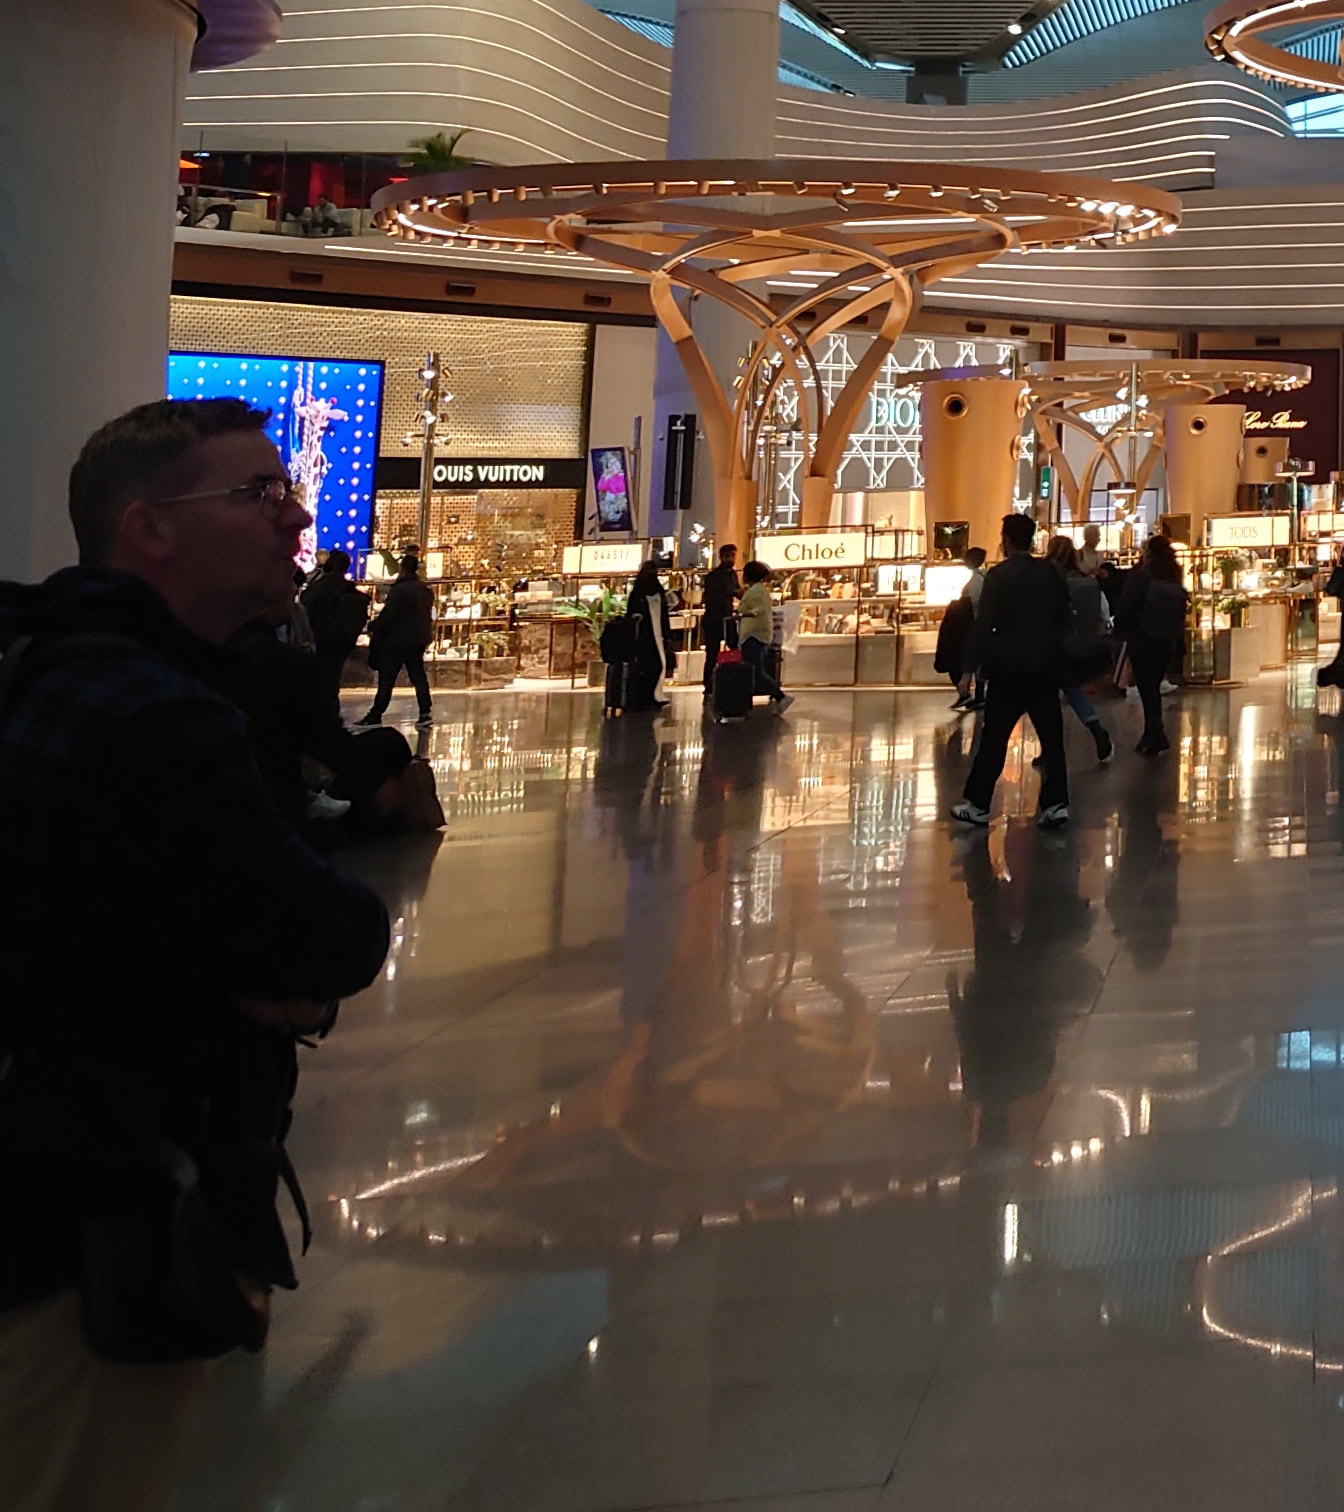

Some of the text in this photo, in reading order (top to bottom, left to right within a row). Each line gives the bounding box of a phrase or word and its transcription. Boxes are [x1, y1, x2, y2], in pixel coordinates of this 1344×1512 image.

[433, 465, 544, 482] OUIS VUITTON
[784, 542, 845, 562] Chloé
